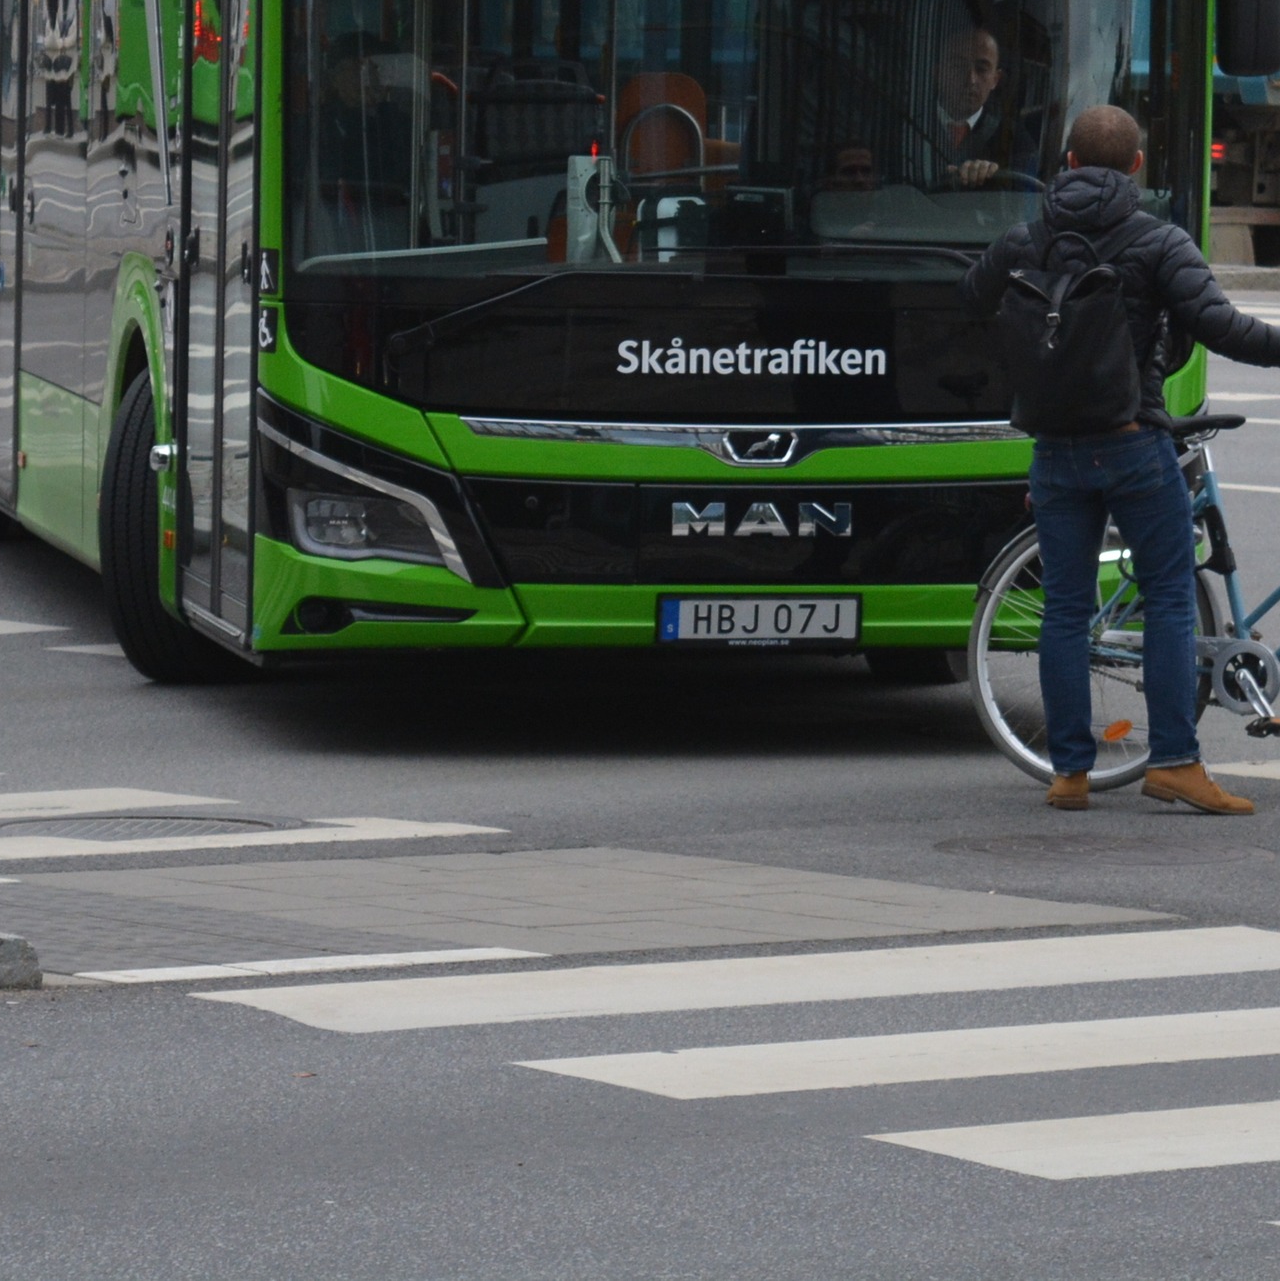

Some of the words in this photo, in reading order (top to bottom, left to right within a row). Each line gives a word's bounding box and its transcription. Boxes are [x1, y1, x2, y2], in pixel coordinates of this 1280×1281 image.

[616, 337, 887, 376] Skånetrafiken
[671, 502, 852, 537] MAN
[693, 604, 759, 634] HBJ
[773, 603, 841, 634] 07J
